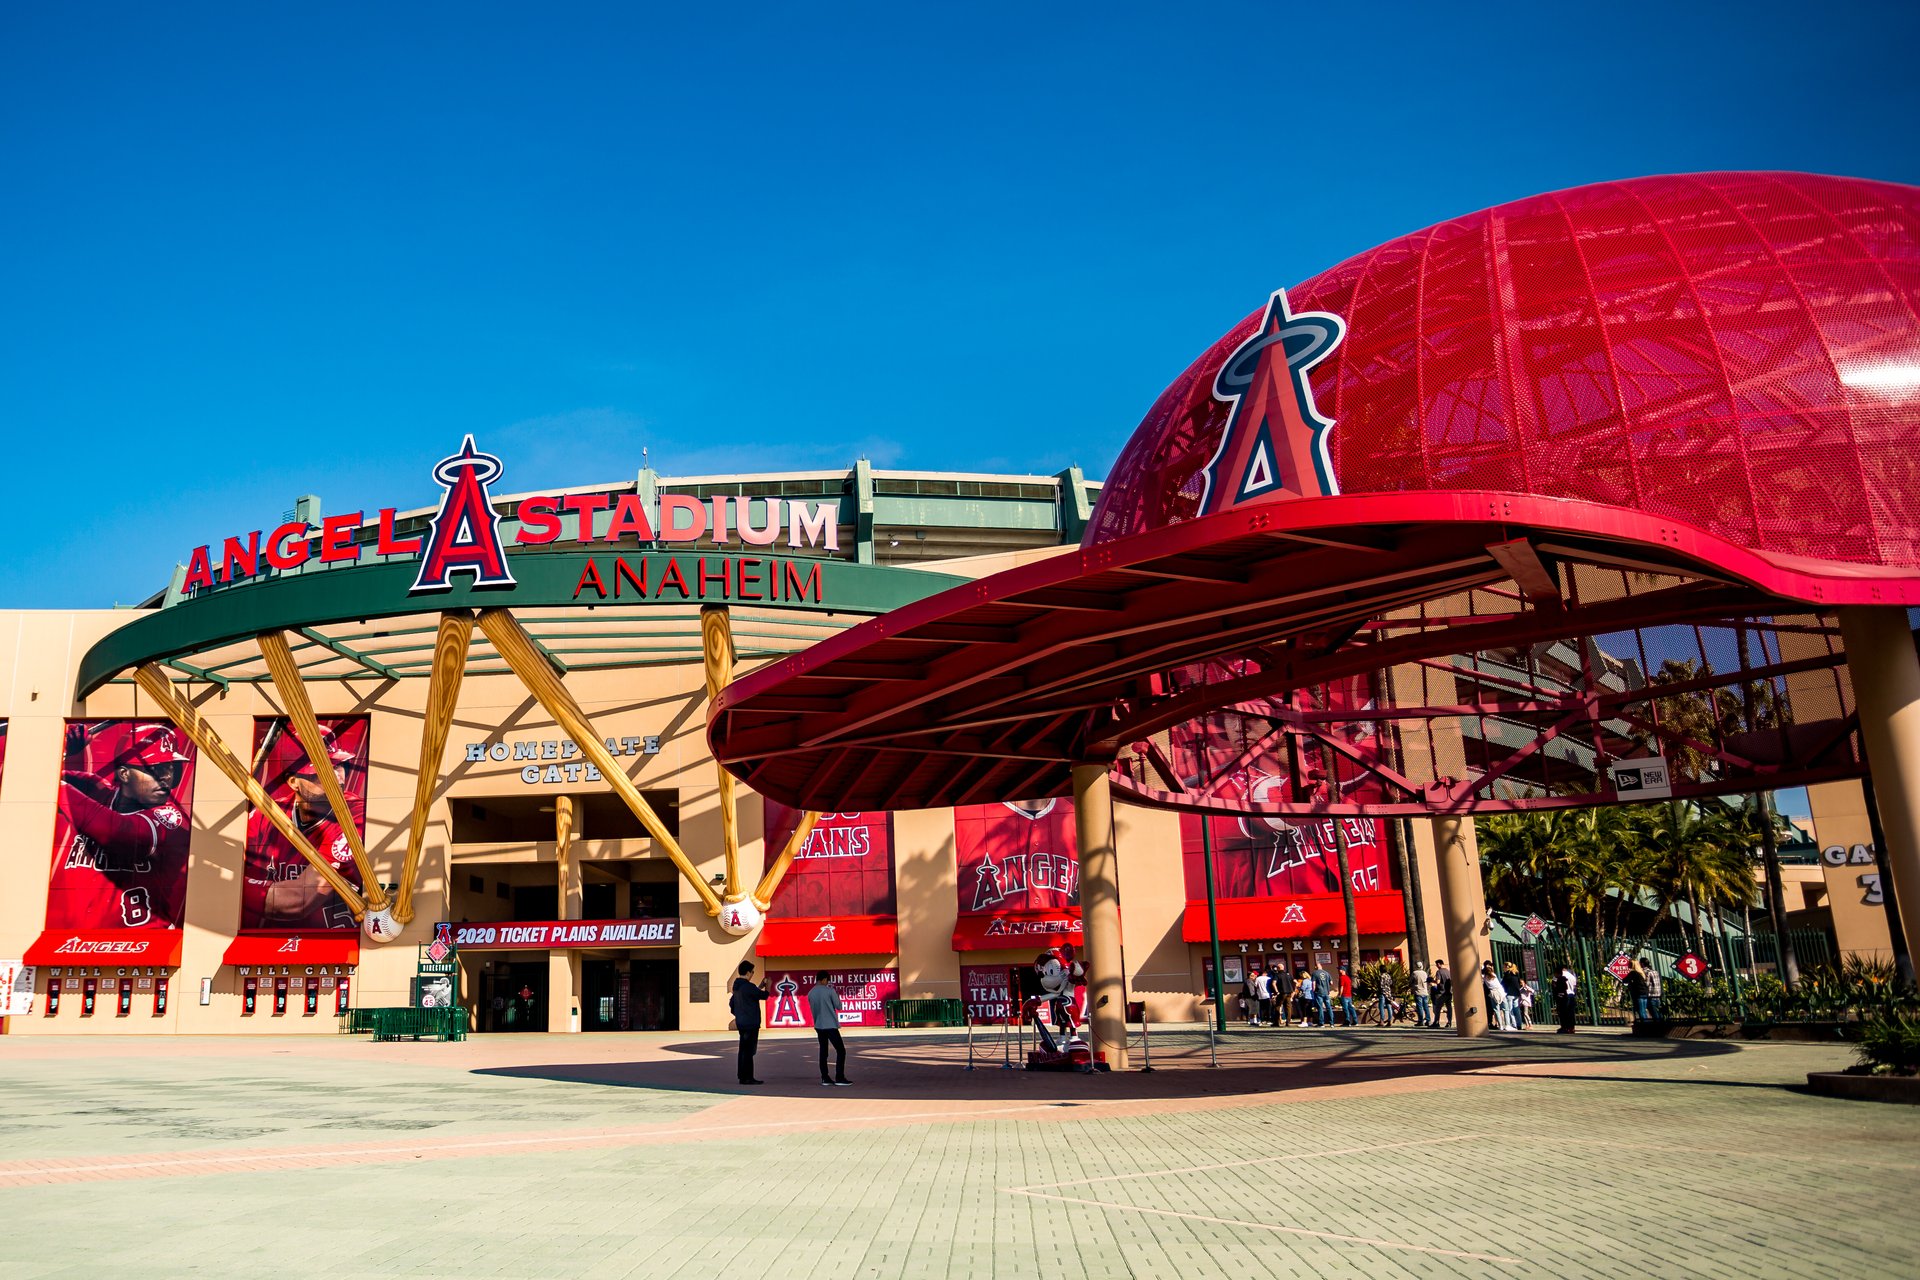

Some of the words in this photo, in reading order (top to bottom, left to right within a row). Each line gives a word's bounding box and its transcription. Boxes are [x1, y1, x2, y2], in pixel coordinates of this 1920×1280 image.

[409, 433, 517, 591] A
[515, 493, 840, 551] STADIUM
[181, 508, 423, 594] ANGEL
[573, 556, 823, 602] ANAHEIM
[466, 735, 660, 762] HOMEPATE
[521, 763, 601, 784] GATE
[1644, 777, 1663, 785] ERA
[1824, 844, 1876, 864] GA
[1858, 874, 1883, 903] 3
[120, 887, 152, 927] 8
[457, 928, 496, 944] 2020
[500, 926, 548, 943] TICKET
[551, 925, 597, 942] PLANS
[600, 923, 675, 941] AVAILABLE
[54, 936, 149, 953] ANGELS
[1238, 938, 1341, 953] TICKET
[51, 967, 101, 977] WILL
[117, 967, 168, 976] CALL
[239, 967, 290, 976] WILL
[305, 966, 356, 975] CALL
[422, 964, 452, 972] DIRECTORY
[1685, 957, 1698, 974] 3
[802, 974, 844, 985] STUM
[848, 973, 896, 983] EXCLUSIVE
[830, 984, 878, 1000] NGELS
[970, 988, 1009, 1001] TEAM
[841, 1000, 882, 1011] HANDISE
